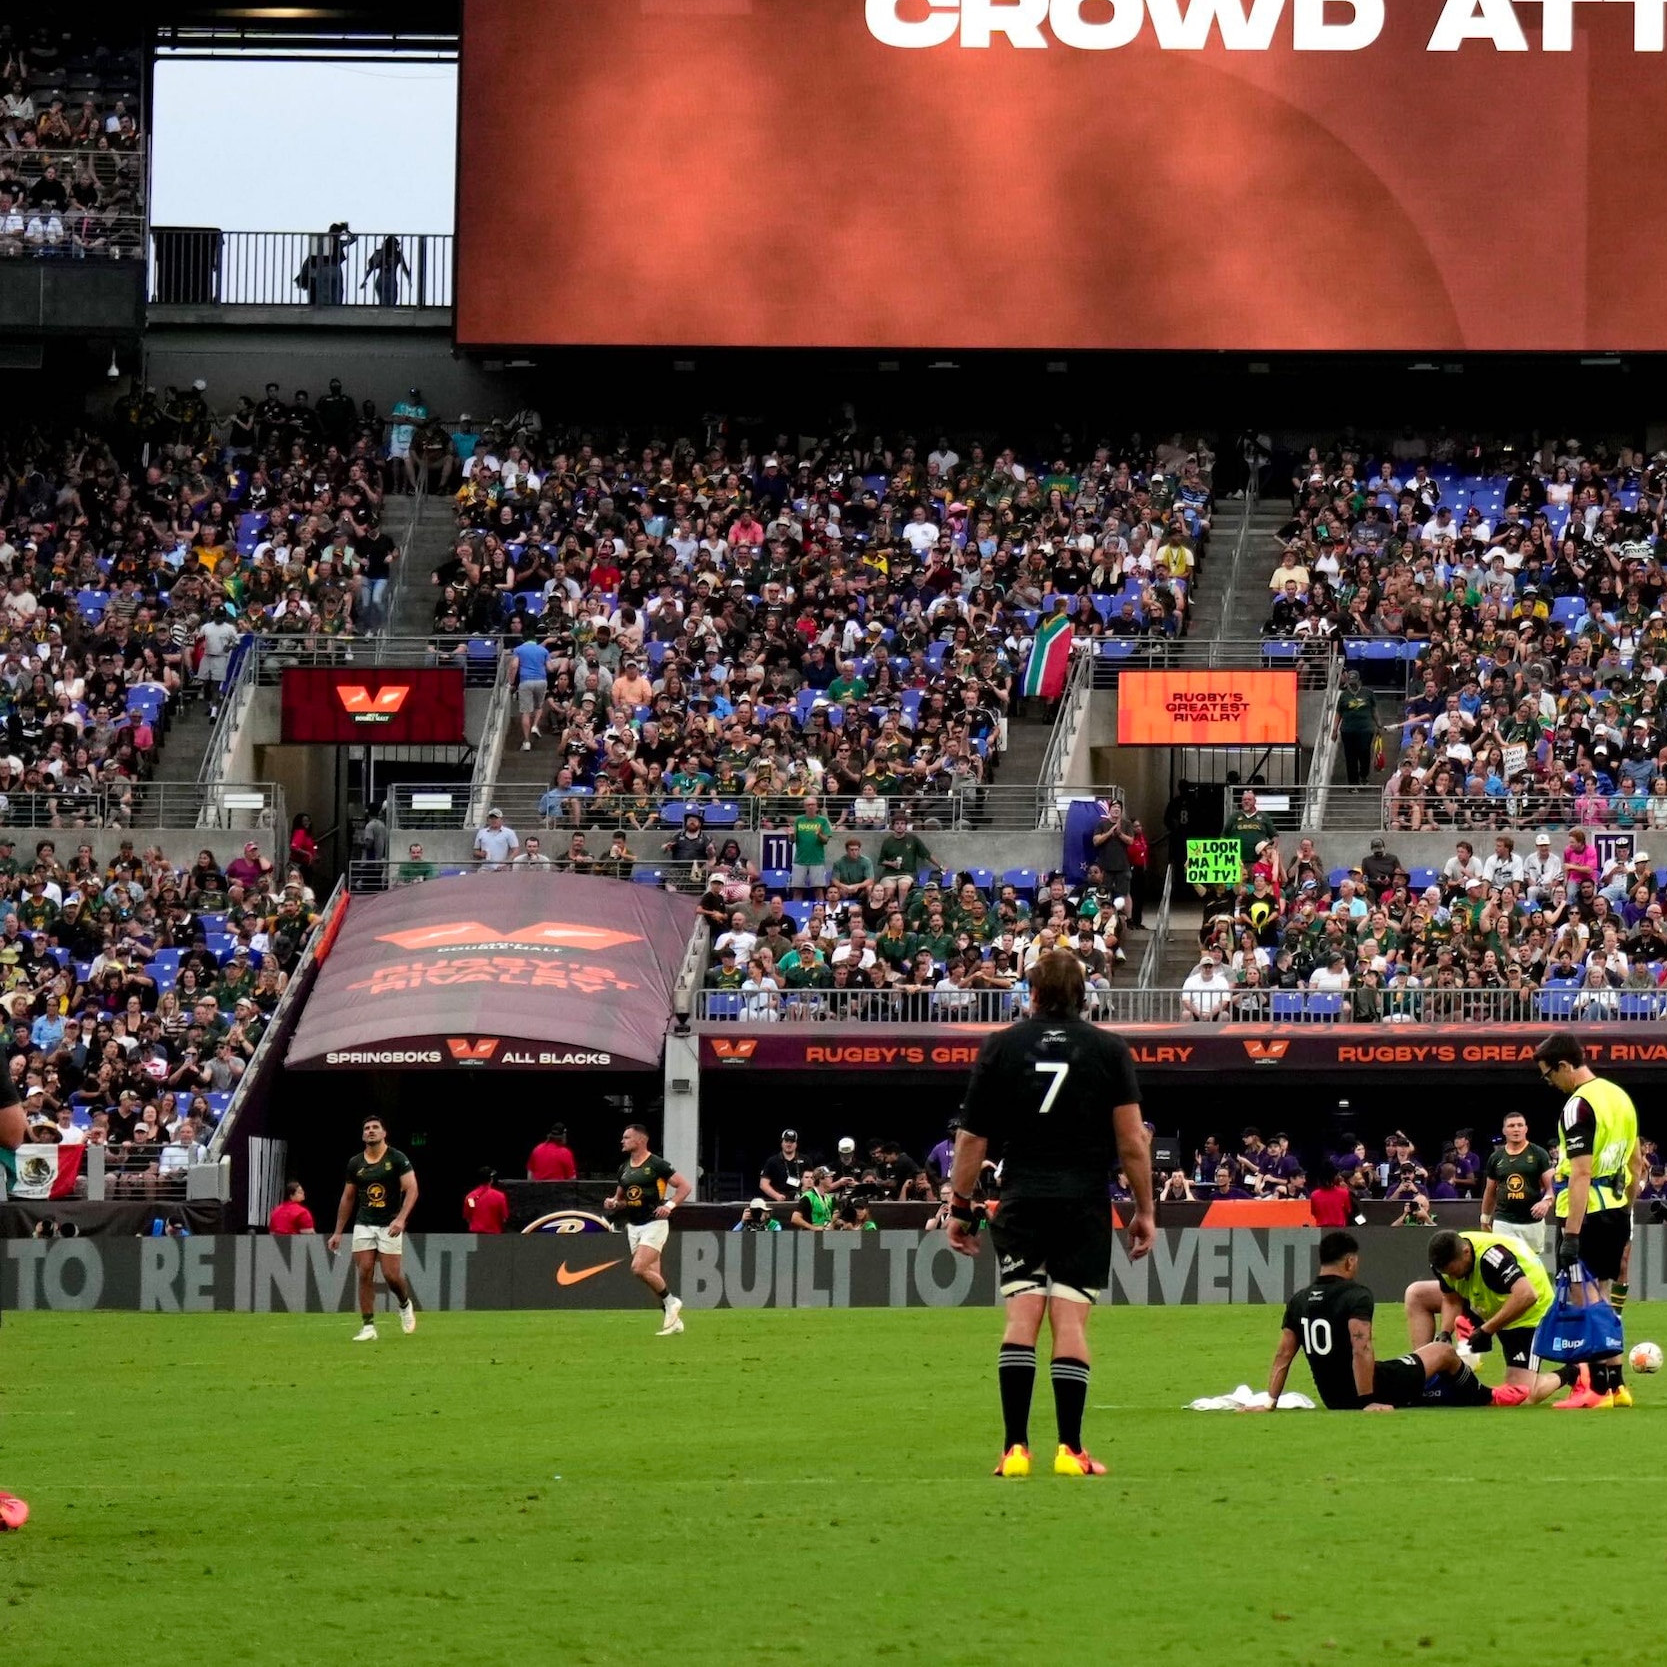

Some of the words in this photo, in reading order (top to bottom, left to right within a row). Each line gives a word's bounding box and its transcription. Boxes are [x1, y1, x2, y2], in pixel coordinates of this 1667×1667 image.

[1172, 693, 1243, 703] RUGBY'S
[1165, 703, 1250, 713] GREATEST
[1173, 713, 1241, 722] RIVALRY
[1202, 842, 1239, 855] LOOK
[1188, 857, 1210, 870] MA
[1214, 854, 1236, 868] I'M
[1189, 869, 1209, 883] ON
[1213, 869, 1237, 883] TV!
[326, 1052, 442, 1065] SPRINGBOKS
[501, 1053, 535, 1065] ALL
[540, 1053, 611, 1065] BLACKS
[806, 1047, 924, 1064] RUGBY'S
[1337, 1046, 1456, 1063] RUGBY'S
[1035, 1062, 1069, 1113] 7
[1507, 1191, 1525, 1200] FNB
[8, 1235, 104, 1310] TO
[682, 1231, 864, 1308] BUILT
[884, 1231, 975, 1308] TO
[1301, 1317, 1332, 1356] 10
